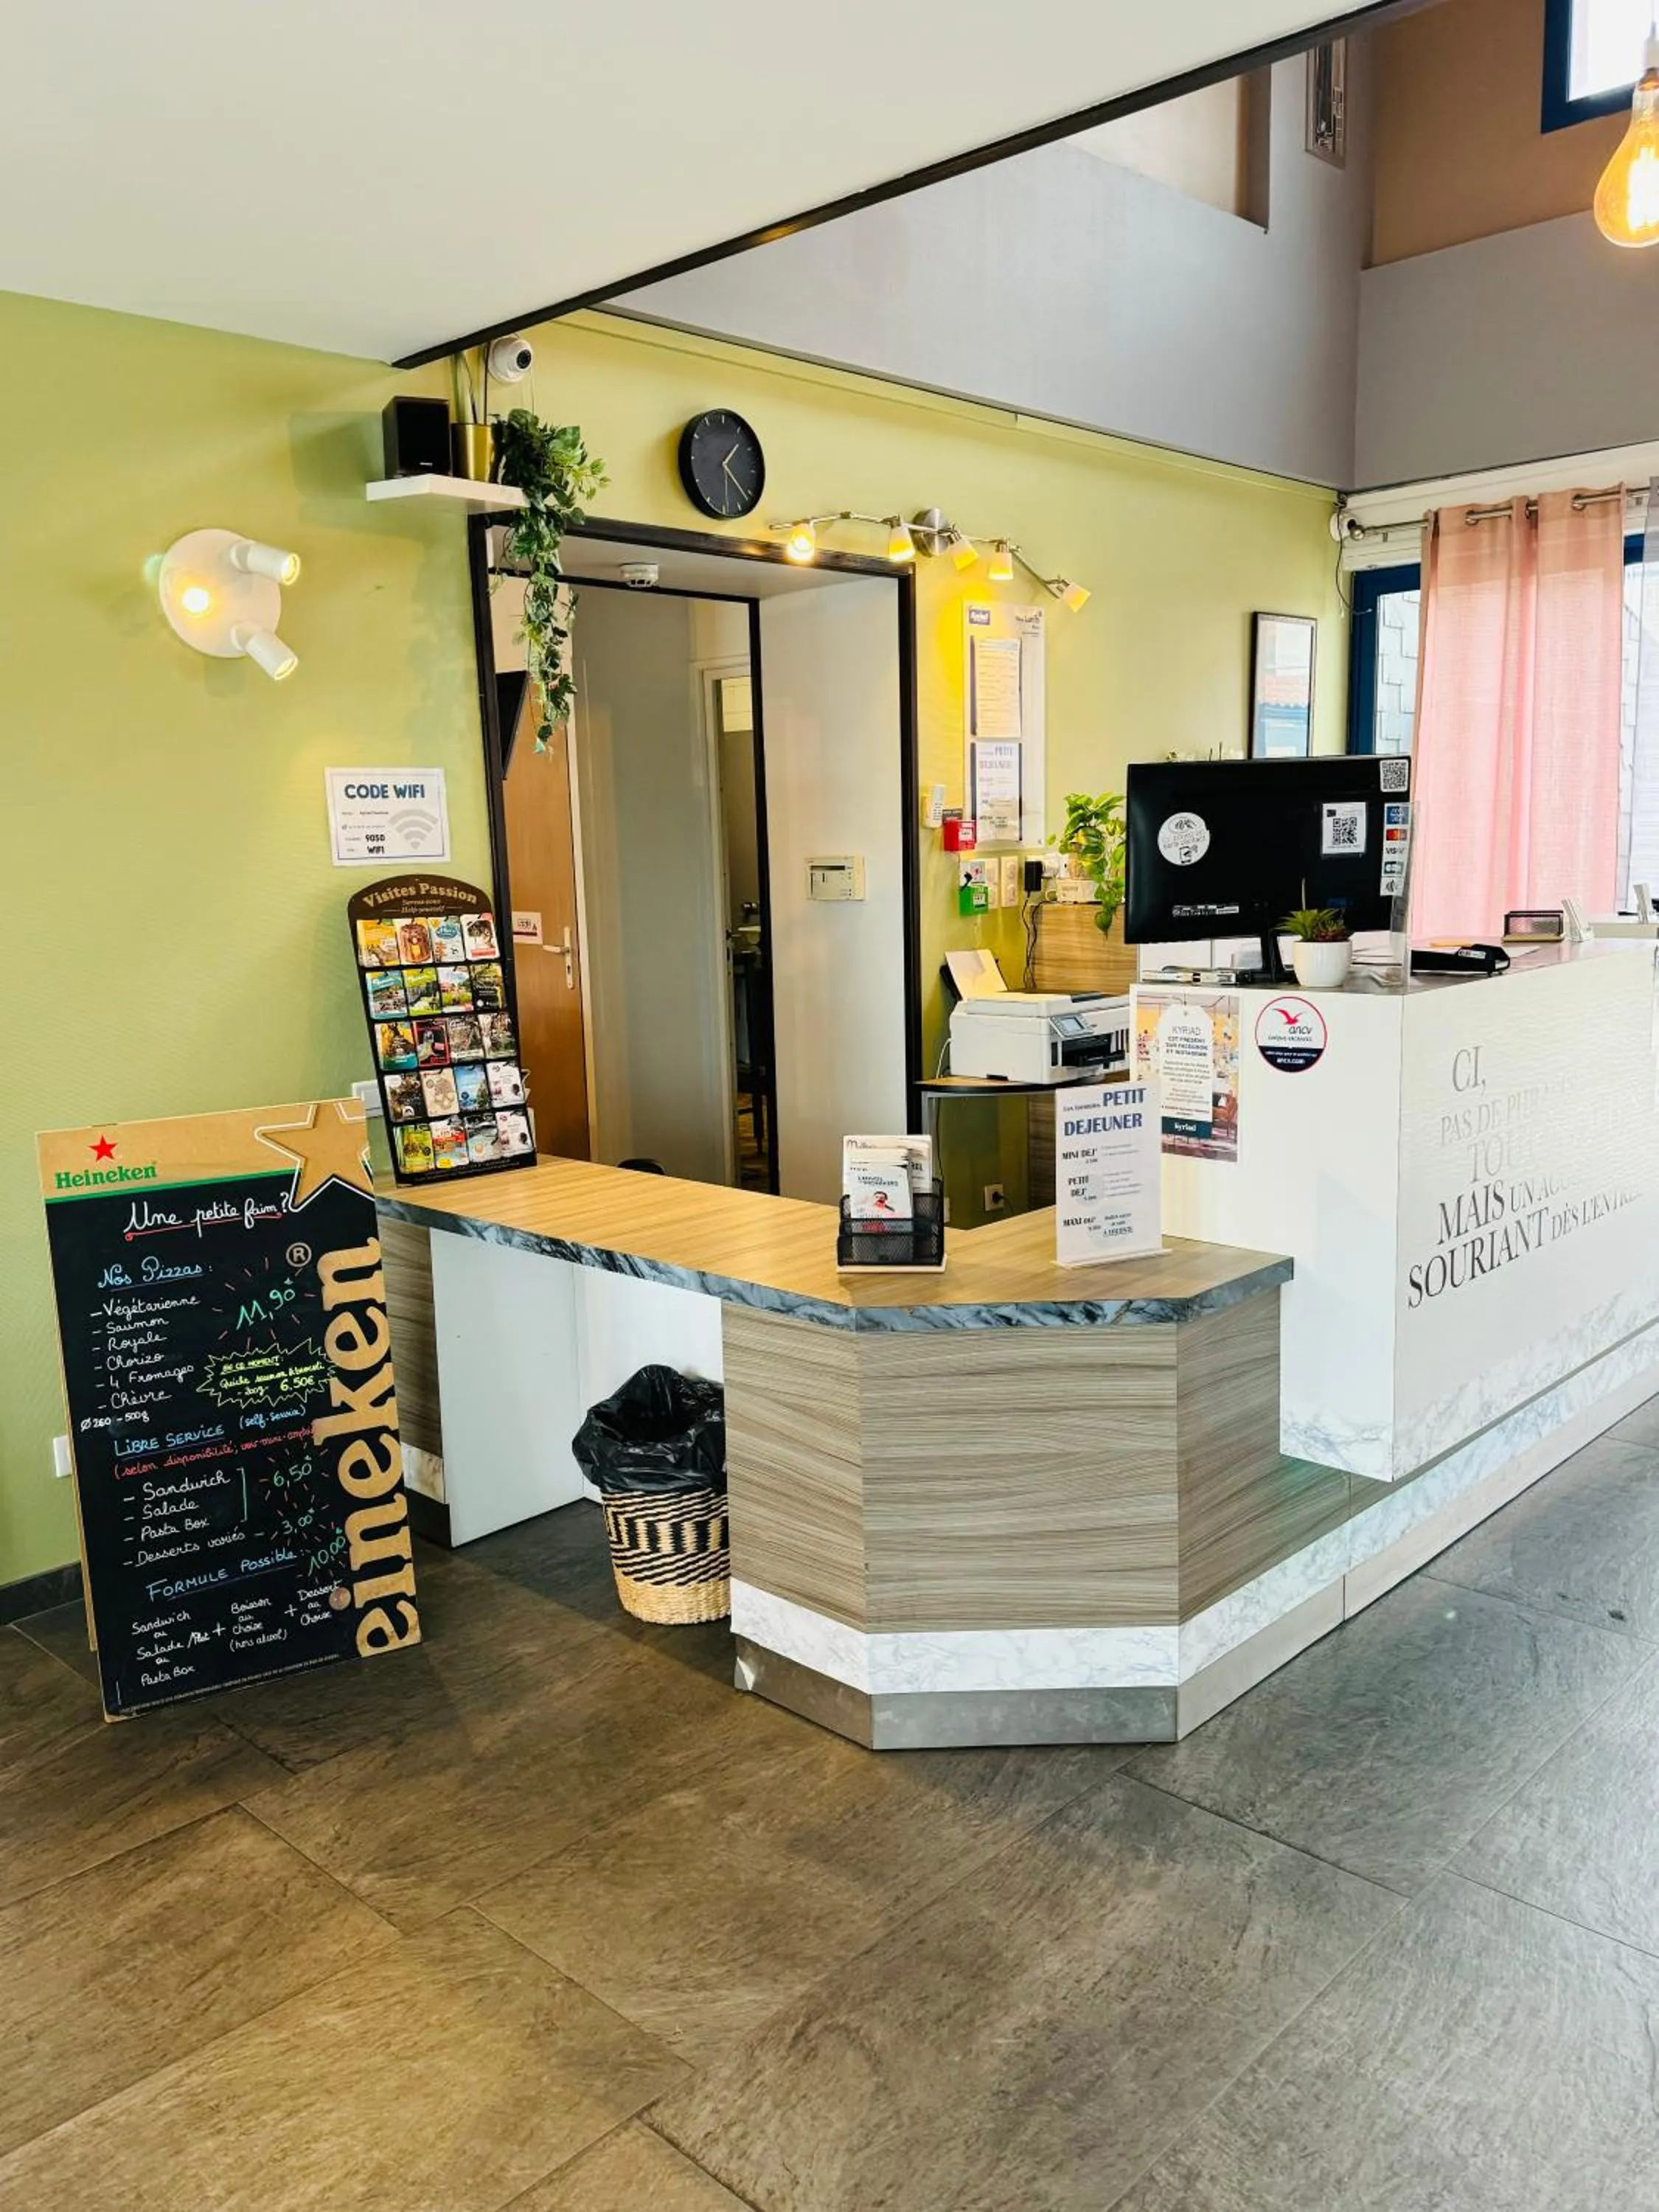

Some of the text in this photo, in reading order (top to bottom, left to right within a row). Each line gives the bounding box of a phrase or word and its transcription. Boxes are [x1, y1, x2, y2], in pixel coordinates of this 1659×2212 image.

[344, 784, 425, 799] CODE WIFI
[366, 846, 385, 855] WIFI
[363, 883, 478, 908] Visites Passion
[1102, 1088, 1147, 1107] PETIT
[1064, 1113, 1143, 1136] DEJEUNER
[55, 1164, 157, 1189] Heineken
[123, 1200, 183, 1234] Une
[190, 1200, 240, 1239] petite
[1437, 1179, 1506, 1246] MAIS
[1408, 1206, 1549, 1310] SOURIANT
[97, 1263, 131, 1290] Nos
[105, 1318, 170, 1334] Saumon
[108, 1331, 168, 1354] Royale
[106, 1352, 165, 1371] Chorizo
[111, 1390, 173, 1409] Chèvre
[142, 1469, 231, 1501] Sandwich
[142, 1498, 200, 1520] Salade
[141, 1517, 210, 1542] Pasta Box
[135, 1542, 201, 1568] Desserts
[131, 1610, 192, 1635] Sandwich
[136, 1639, 185, 1660] Salade
